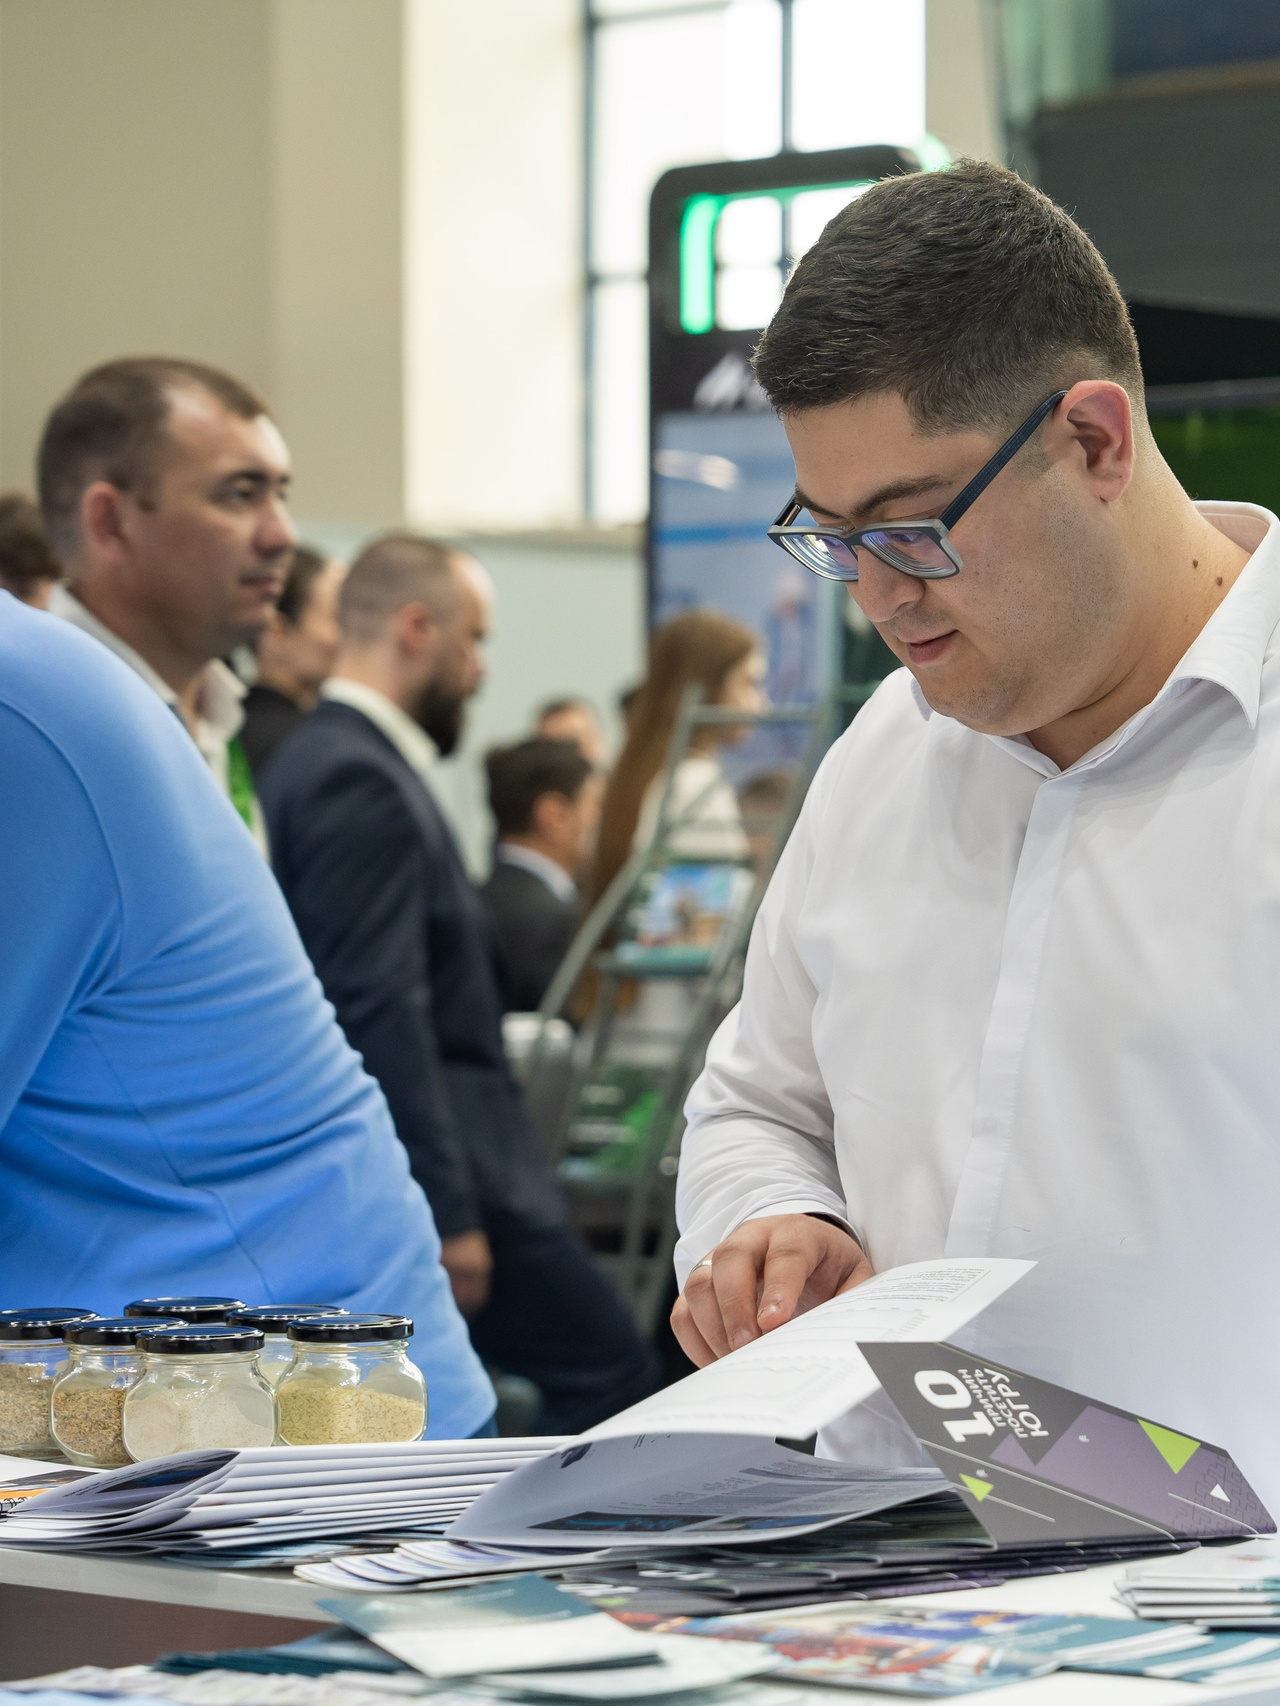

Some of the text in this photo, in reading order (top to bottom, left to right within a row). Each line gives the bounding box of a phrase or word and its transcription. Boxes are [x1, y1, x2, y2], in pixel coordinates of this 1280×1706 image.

[913, 1369, 996, 1443] 10
[957, 1368, 1007, 1428] ПРИЧИН
[973, 1368, 1029, 1439] ПОСЕТИТЬ
[983, 1367, 1050, 1438] ЮГРУ
